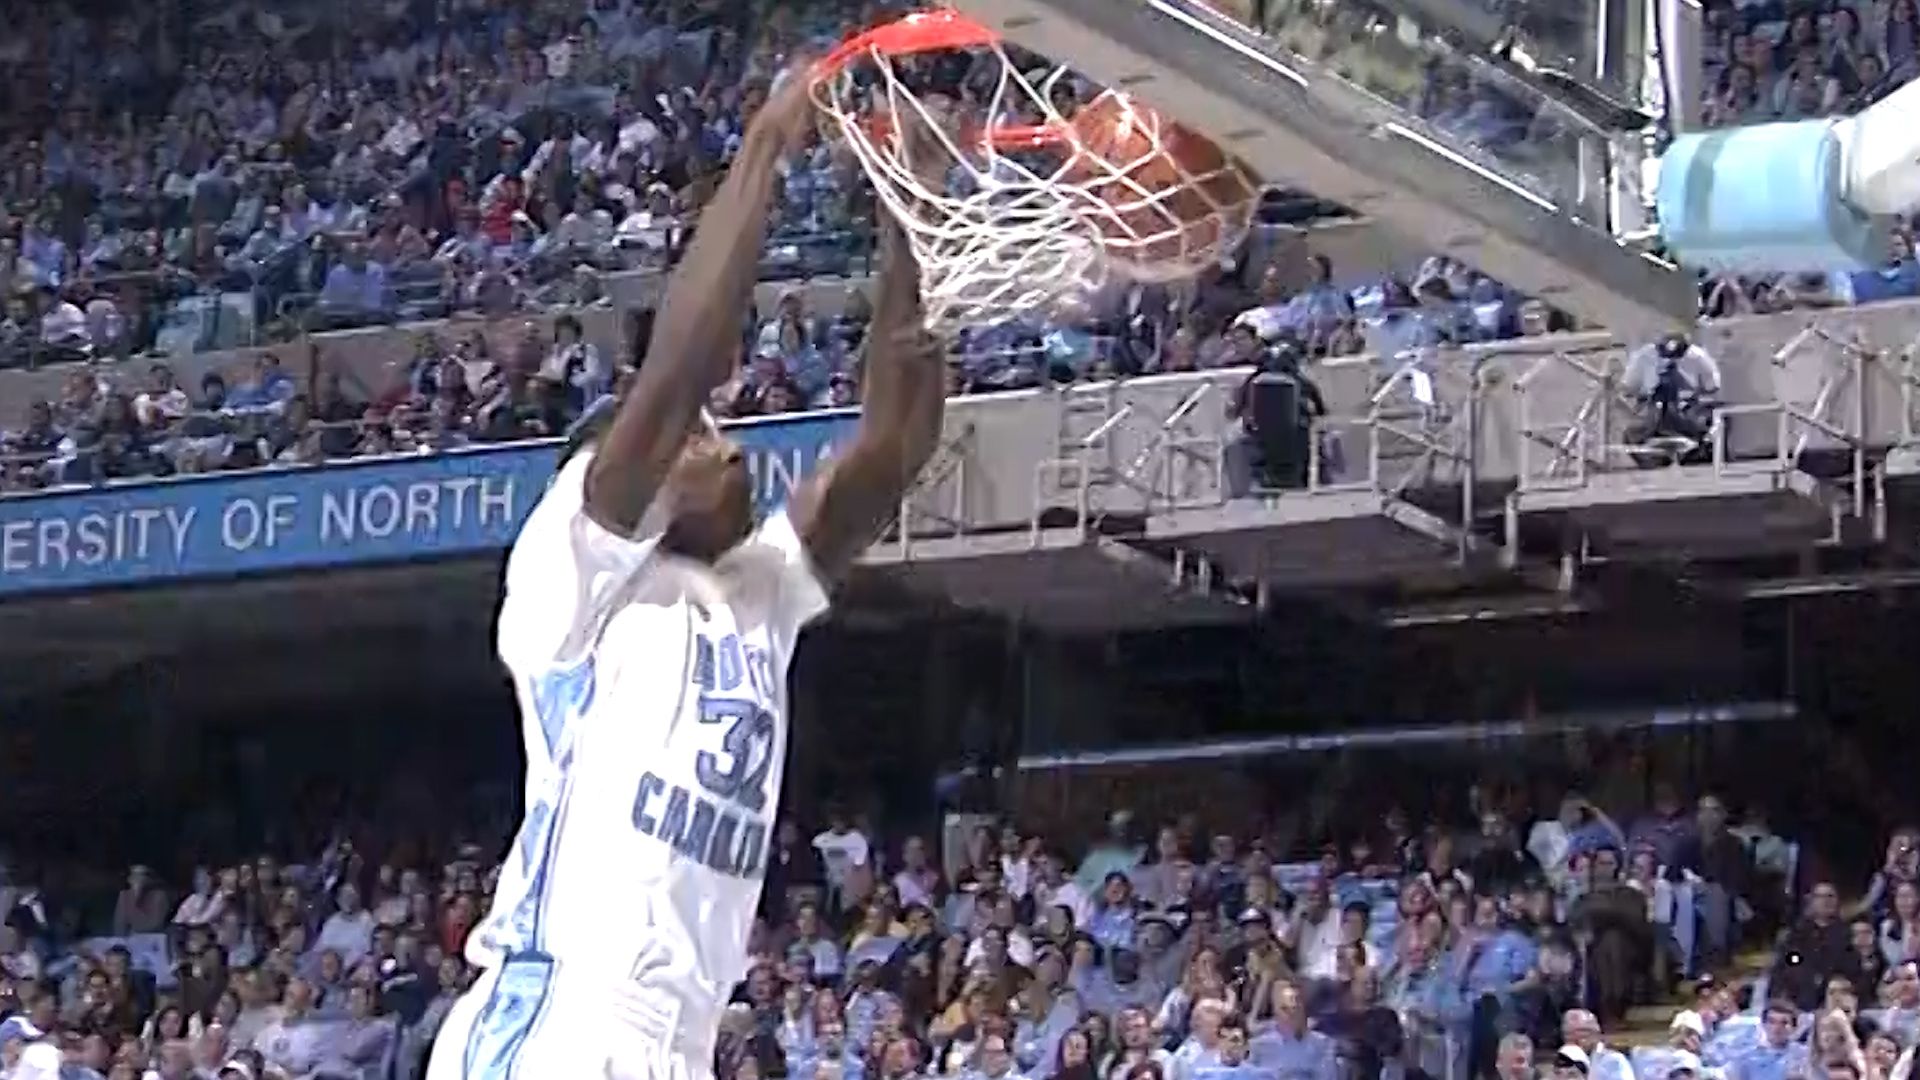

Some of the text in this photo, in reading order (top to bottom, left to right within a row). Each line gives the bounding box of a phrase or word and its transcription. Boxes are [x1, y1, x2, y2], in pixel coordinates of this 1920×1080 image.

[3, 505, 197, 572] ERSITY
[222, 496, 298, 550] OF
[320, 477, 514, 541] NORTH
[695, 698, 775, 812] 32
